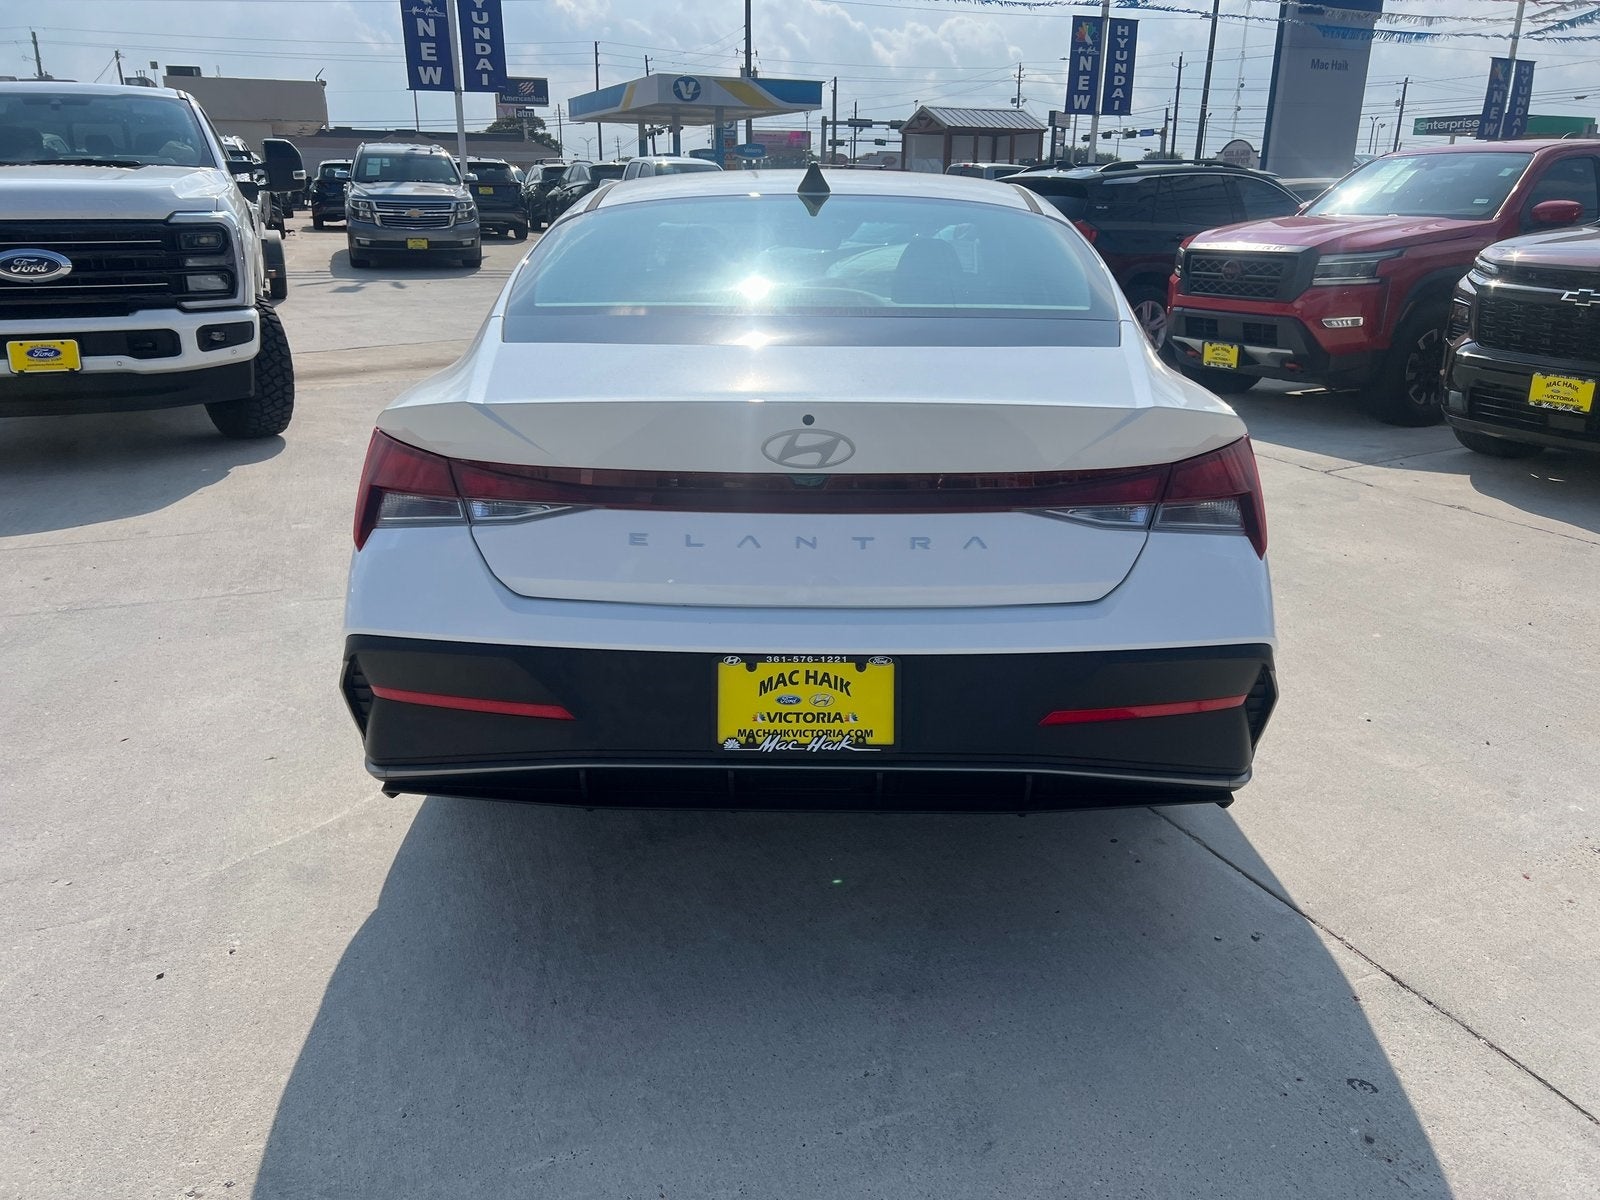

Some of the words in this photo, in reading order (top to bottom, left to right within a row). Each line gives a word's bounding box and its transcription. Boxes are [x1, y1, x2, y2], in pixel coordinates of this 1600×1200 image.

[416, 17, 442, 85] NEW
[1111, 25, 1129, 111] HYUNDAI
[1310, 58, 1329, 71] Mac
[1331, 59, 1349, 72] Haik
[1073, 55, 1092, 110] NEW
[1512, 66, 1529, 136] HYUNDAI
[516, 109, 534, 118] atm
[1483, 90, 1503, 136] NEW
[1416, 117, 1480, 132] enterprise
[10, 257, 48, 273] Ford
[33, 348, 55, 357] Ford
[1546, 380, 1562, 388] MAC
[1547, 393, 1575, 403] VICTORIA
[628, 532, 988, 550] ELANTRA
[758, 669, 800, 697] MAC
[804, 669, 852, 697] HAIK
[779, 695, 799, 704] Ford
[766, 711, 844, 724] VICTORIA
[737, 728, 873, 739] MACHAIKVICTORIA.COM
[759, 734, 805, 753] Mac
[806, 733, 856, 753] Haik
